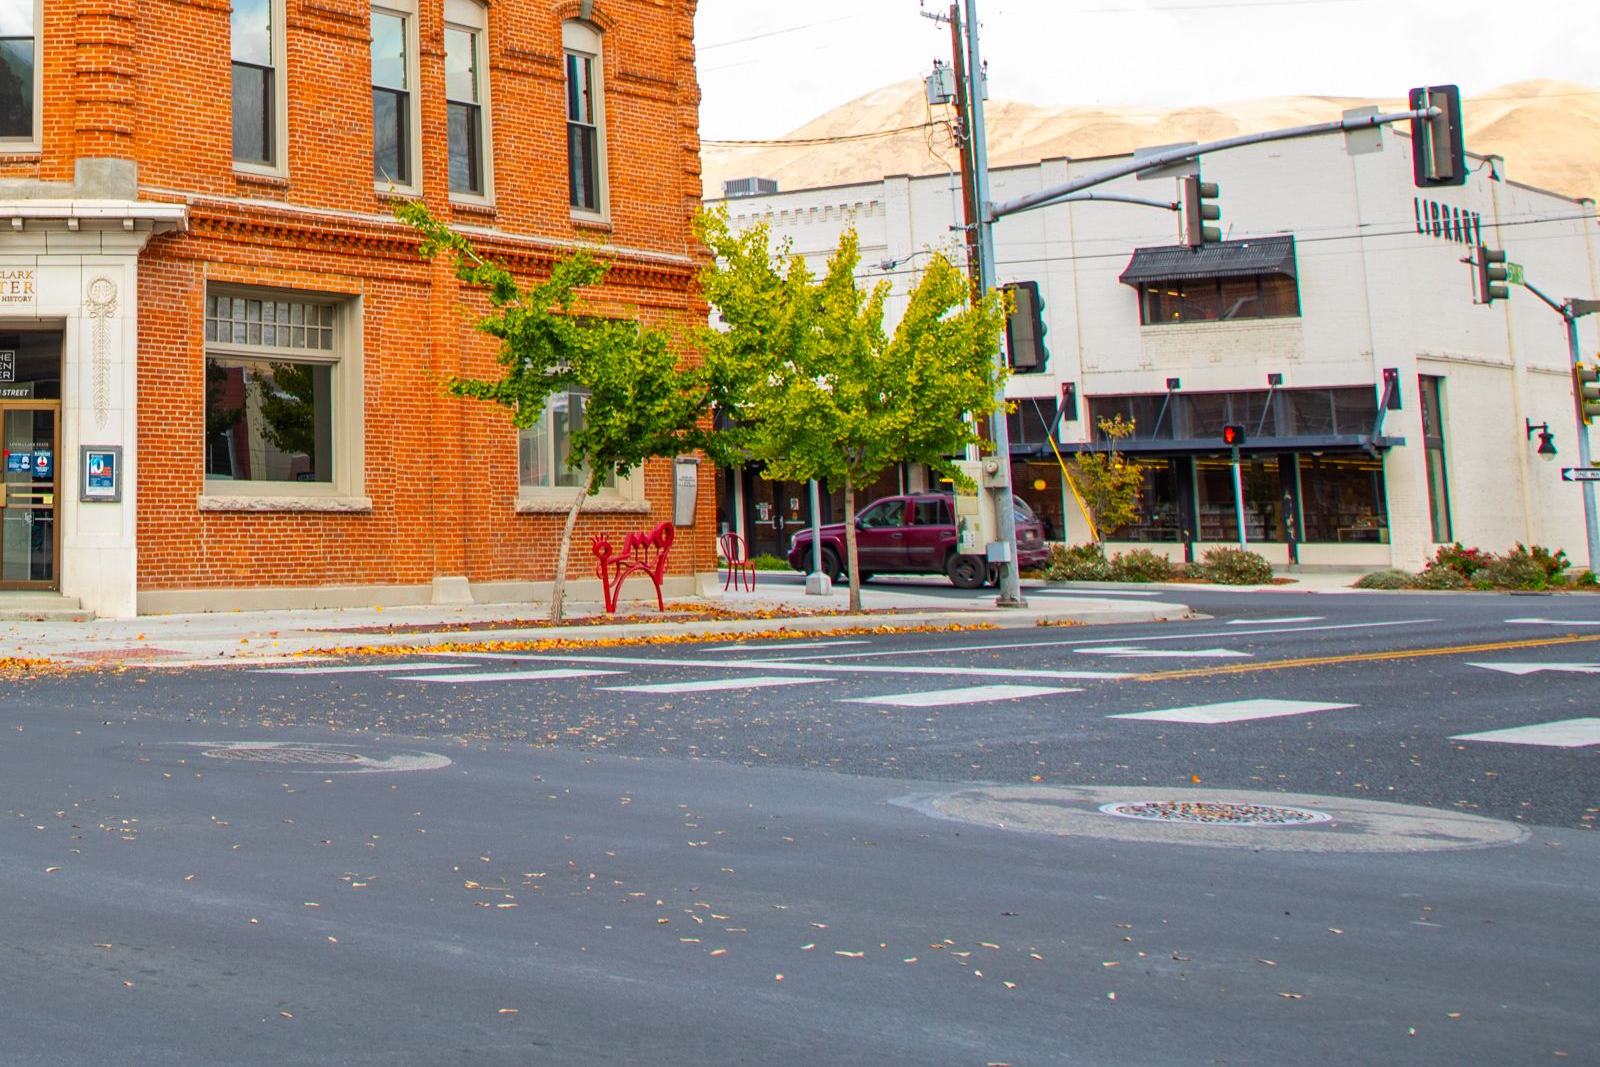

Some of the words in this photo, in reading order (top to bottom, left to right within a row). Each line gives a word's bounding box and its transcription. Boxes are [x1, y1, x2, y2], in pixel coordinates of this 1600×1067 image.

[1413, 196, 1482, 247] LIBRARY
[1, 295, 33, 303] HISTORY
[2, 388, 29, 397] STREET
[89, 457, 105, 474] 10
